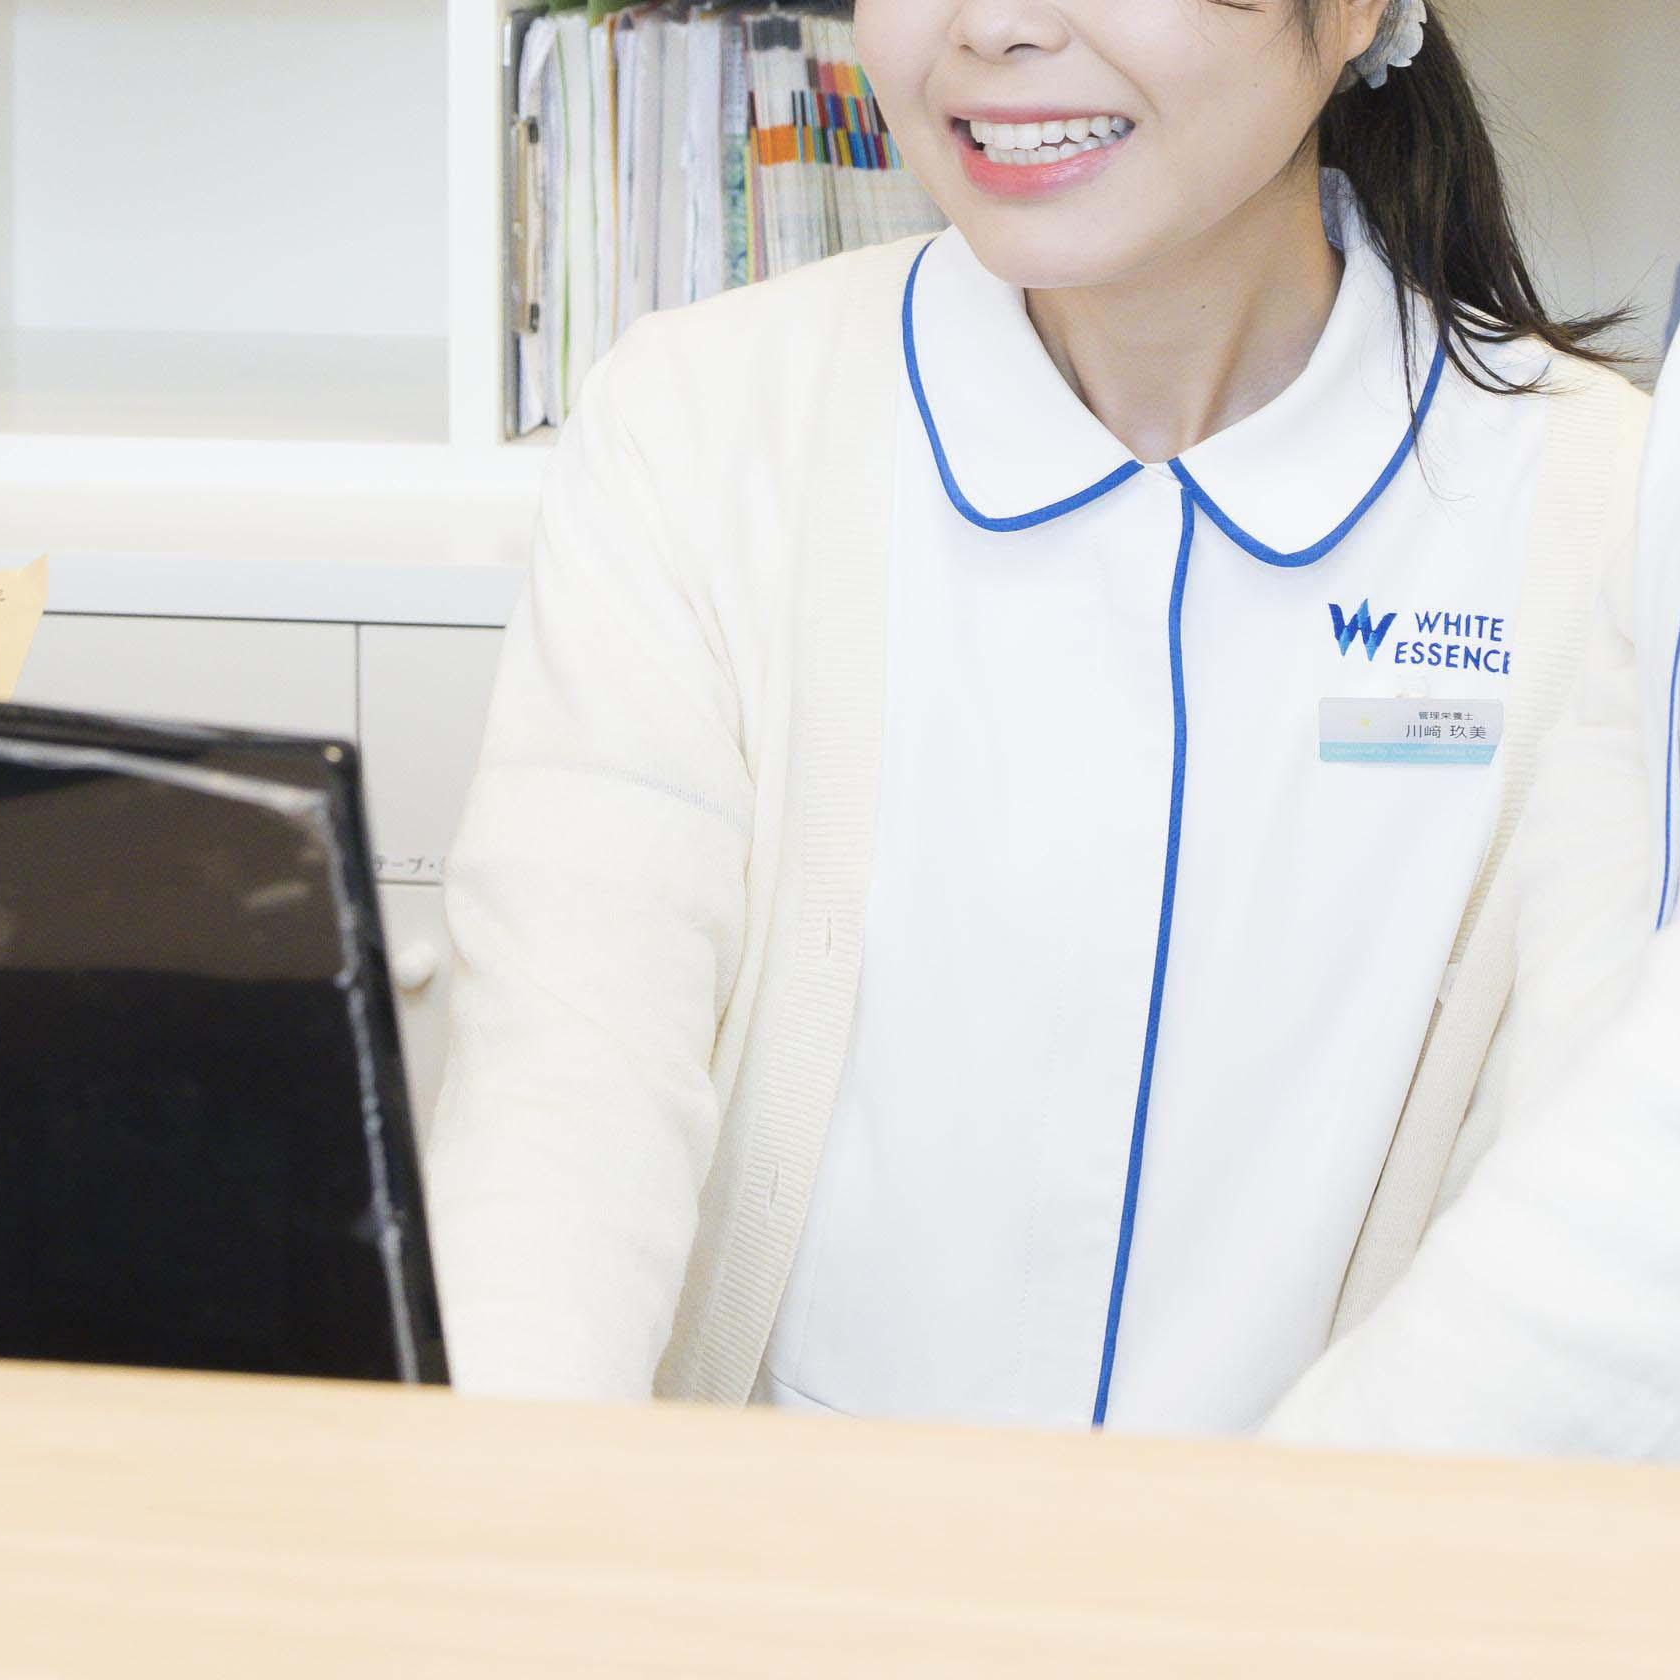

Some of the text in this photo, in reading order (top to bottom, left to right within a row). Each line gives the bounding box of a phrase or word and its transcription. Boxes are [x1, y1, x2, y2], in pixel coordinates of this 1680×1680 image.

[1414, 610, 1505, 642] WHITE
[1418, 711, 1474, 721] 管理栄養士
